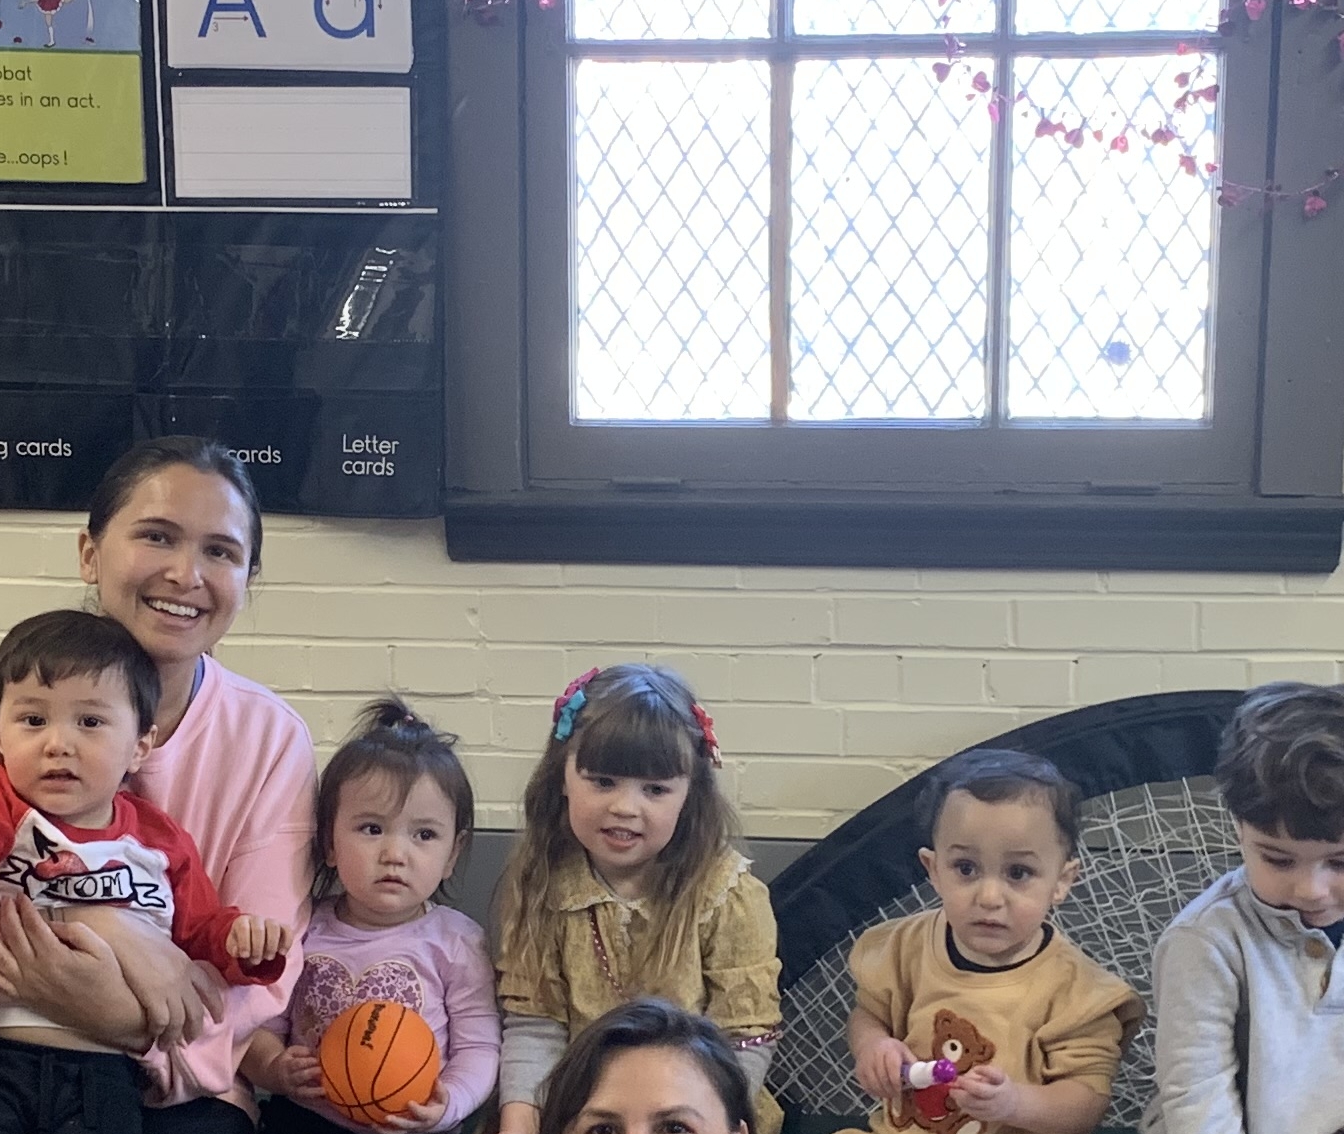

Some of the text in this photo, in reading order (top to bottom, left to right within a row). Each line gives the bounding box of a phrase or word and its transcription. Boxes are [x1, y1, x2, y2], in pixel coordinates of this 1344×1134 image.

[20, 92, 33, 107] in
[40, 94, 61, 108] an
[67, 93, 101, 109] act.
[16, 438, 72, 457] cards
[342, 434, 400, 454] Letter
[342, 457, 395, 476] cards
[48, 872, 124, 897] MOM
